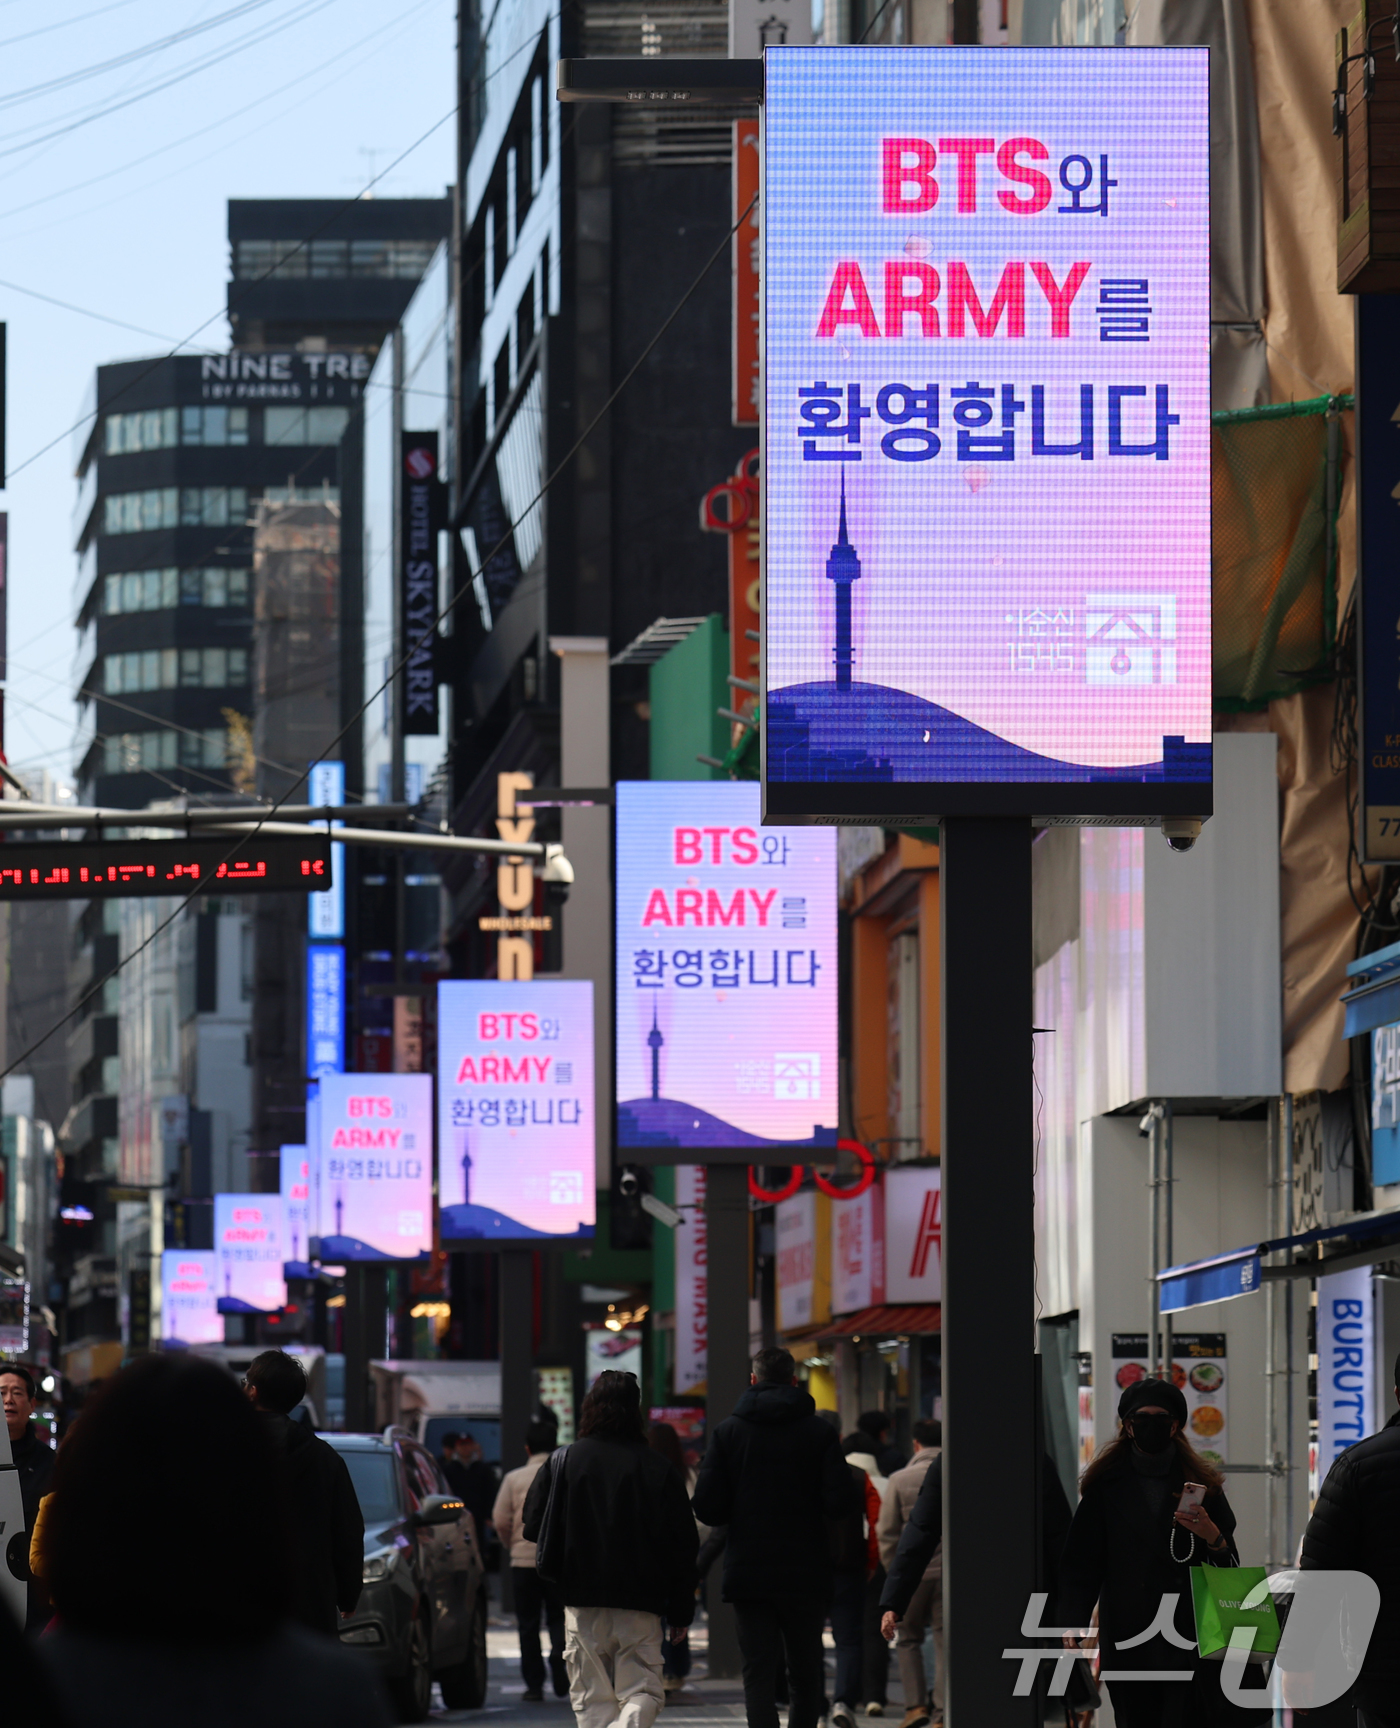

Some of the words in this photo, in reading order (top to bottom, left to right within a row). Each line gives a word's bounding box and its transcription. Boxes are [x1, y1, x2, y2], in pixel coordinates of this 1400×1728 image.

[881, 136, 1118, 217] BTS와
[817, 261, 1153, 342] ARMY를
[797, 380, 1180, 463] 환영합니다
[410, 485, 430, 557] HOTEL
[406, 560, 433, 716] SKYPARK
[1004, 606, 1075, 638] 이순신
[1006, 643, 1075, 672] 1545
[1372, 755, 1400, 769] CLAS
[674, 826, 791, 866] BTS와
[479, 916, 552, 931] WHOLESALE
[642, 888, 807, 929] ARMY를
[633, 949, 821, 989] 환영합니다
[479, 1012, 560, 1041] BTS와
[456, 1056, 573, 1085] ARMY를
[451, 1097, 583, 1128] 환영합니다
[1218, 1599, 1242, 1609] OLIVE
